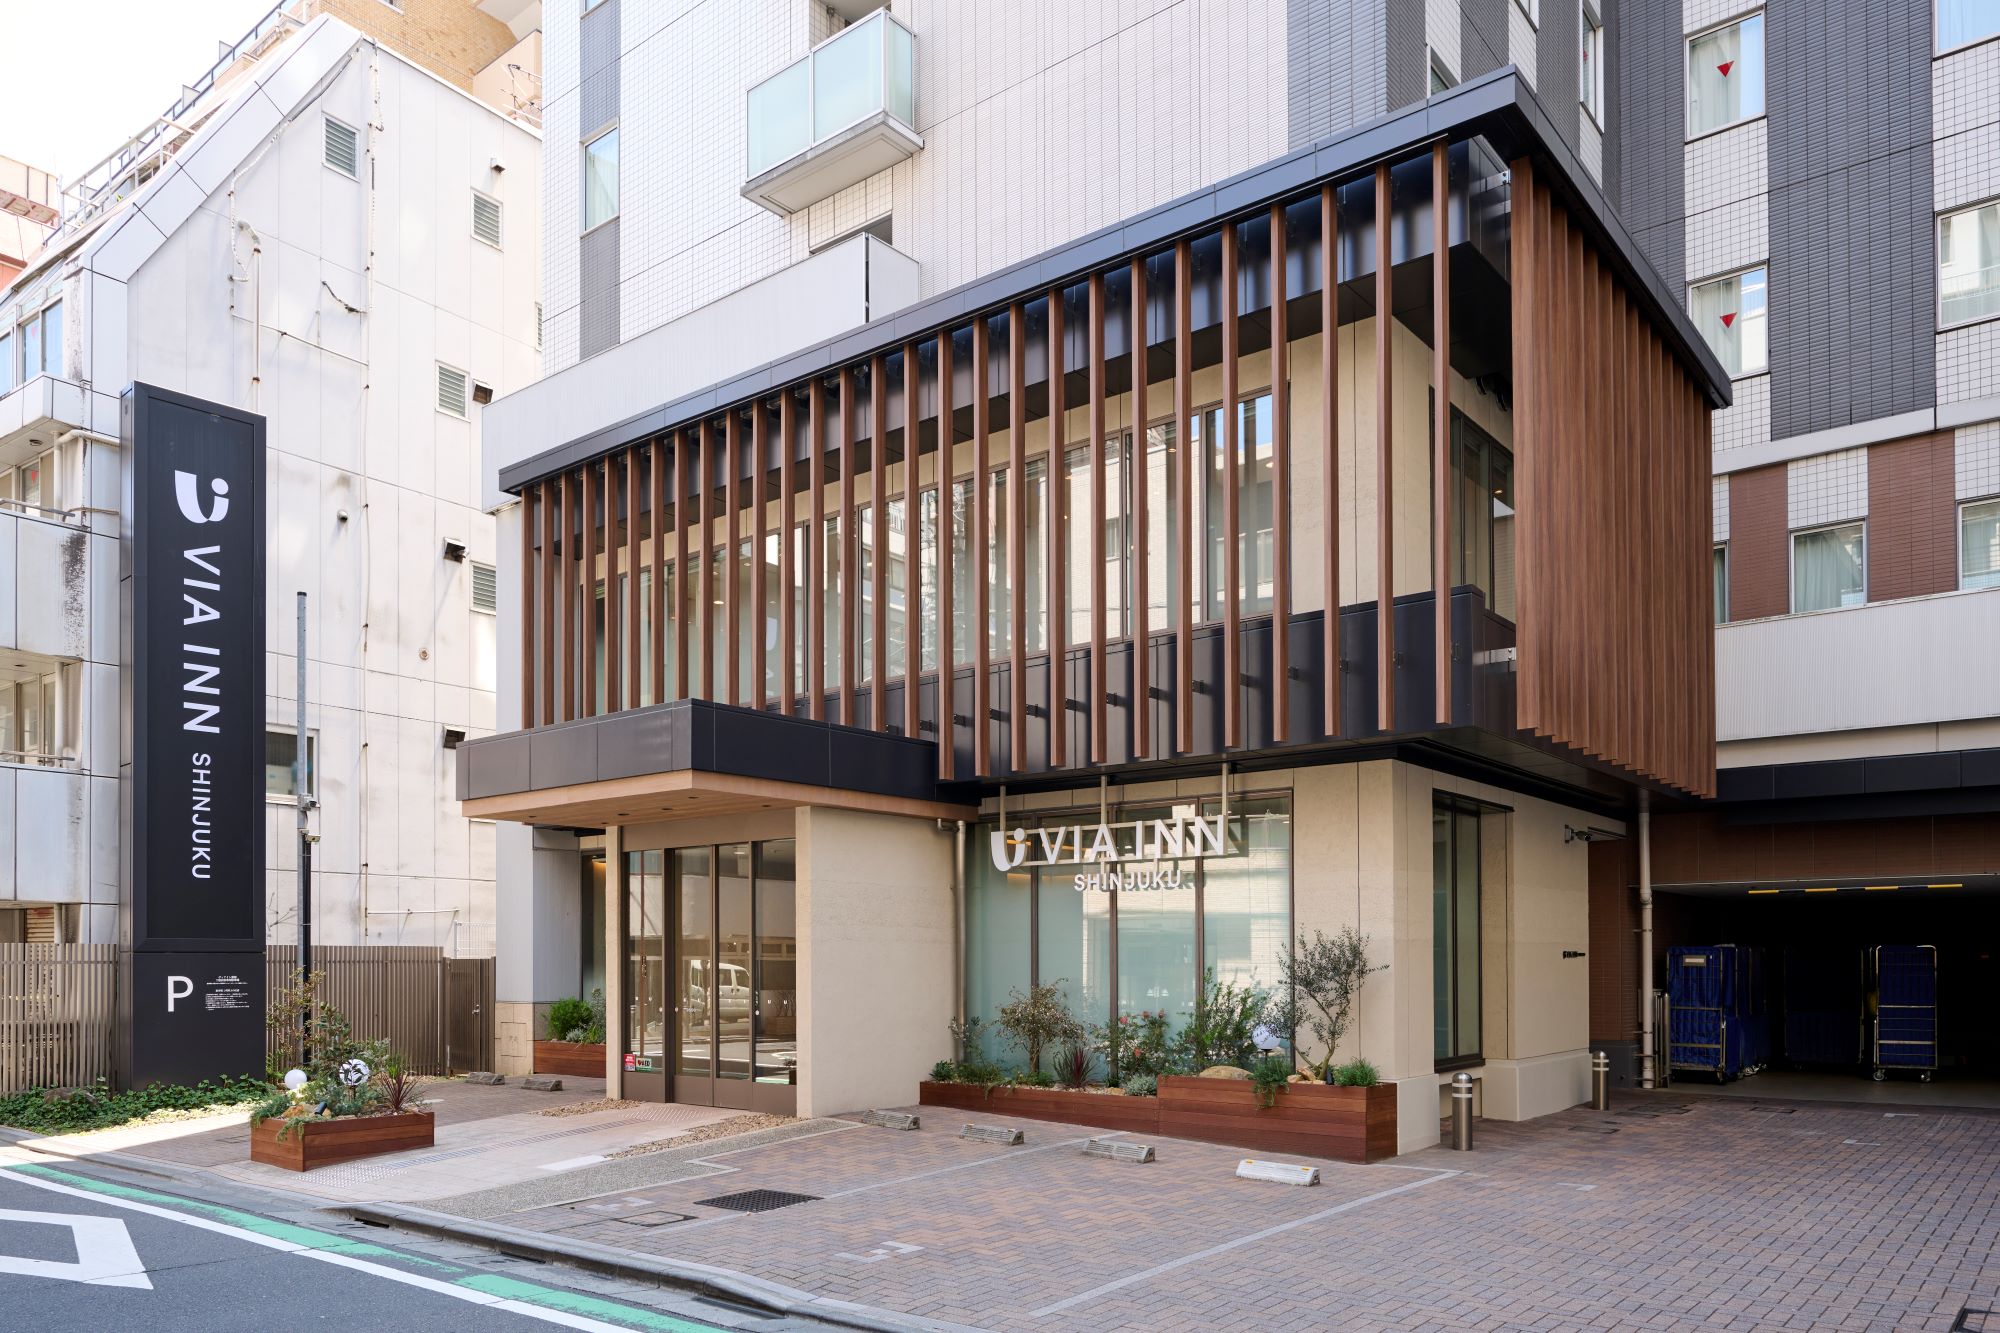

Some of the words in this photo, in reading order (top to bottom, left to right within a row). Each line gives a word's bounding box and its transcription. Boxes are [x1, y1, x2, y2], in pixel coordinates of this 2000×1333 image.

[184, 546, 220, 625] VIA
[184, 644, 220, 734] INN
[192, 752, 211, 879] SHINJUKU
[1039, 823, 1120, 864] VIA
[1136, 814, 1228, 860] INN
[1073, 869, 1183, 892] SHINJUKU
[167, 975, 194, 1013] P
